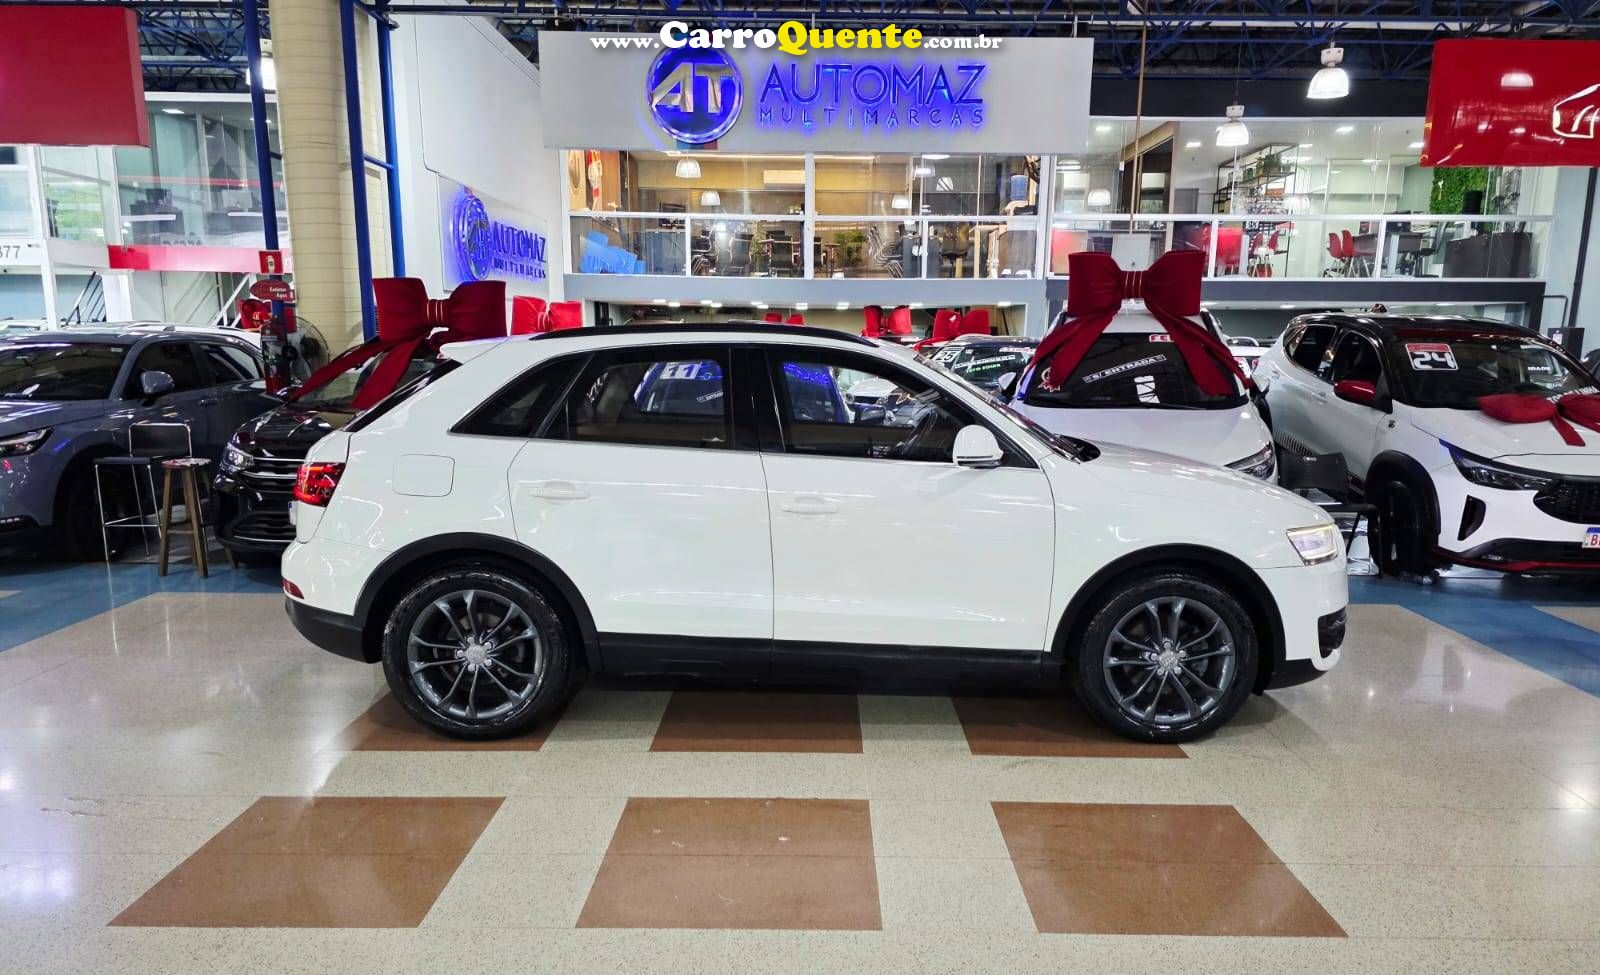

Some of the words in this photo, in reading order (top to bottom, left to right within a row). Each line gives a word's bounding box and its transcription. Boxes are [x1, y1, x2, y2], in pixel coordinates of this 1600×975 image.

[652, 62, 737, 113] AT
[760, 63, 986, 105] AUTOMAZ
[760, 107, 984, 126] MULTIMARCAS
[493, 221, 547, 264] AUTOMAZ
[1413, 351, 1455, 369] 24
